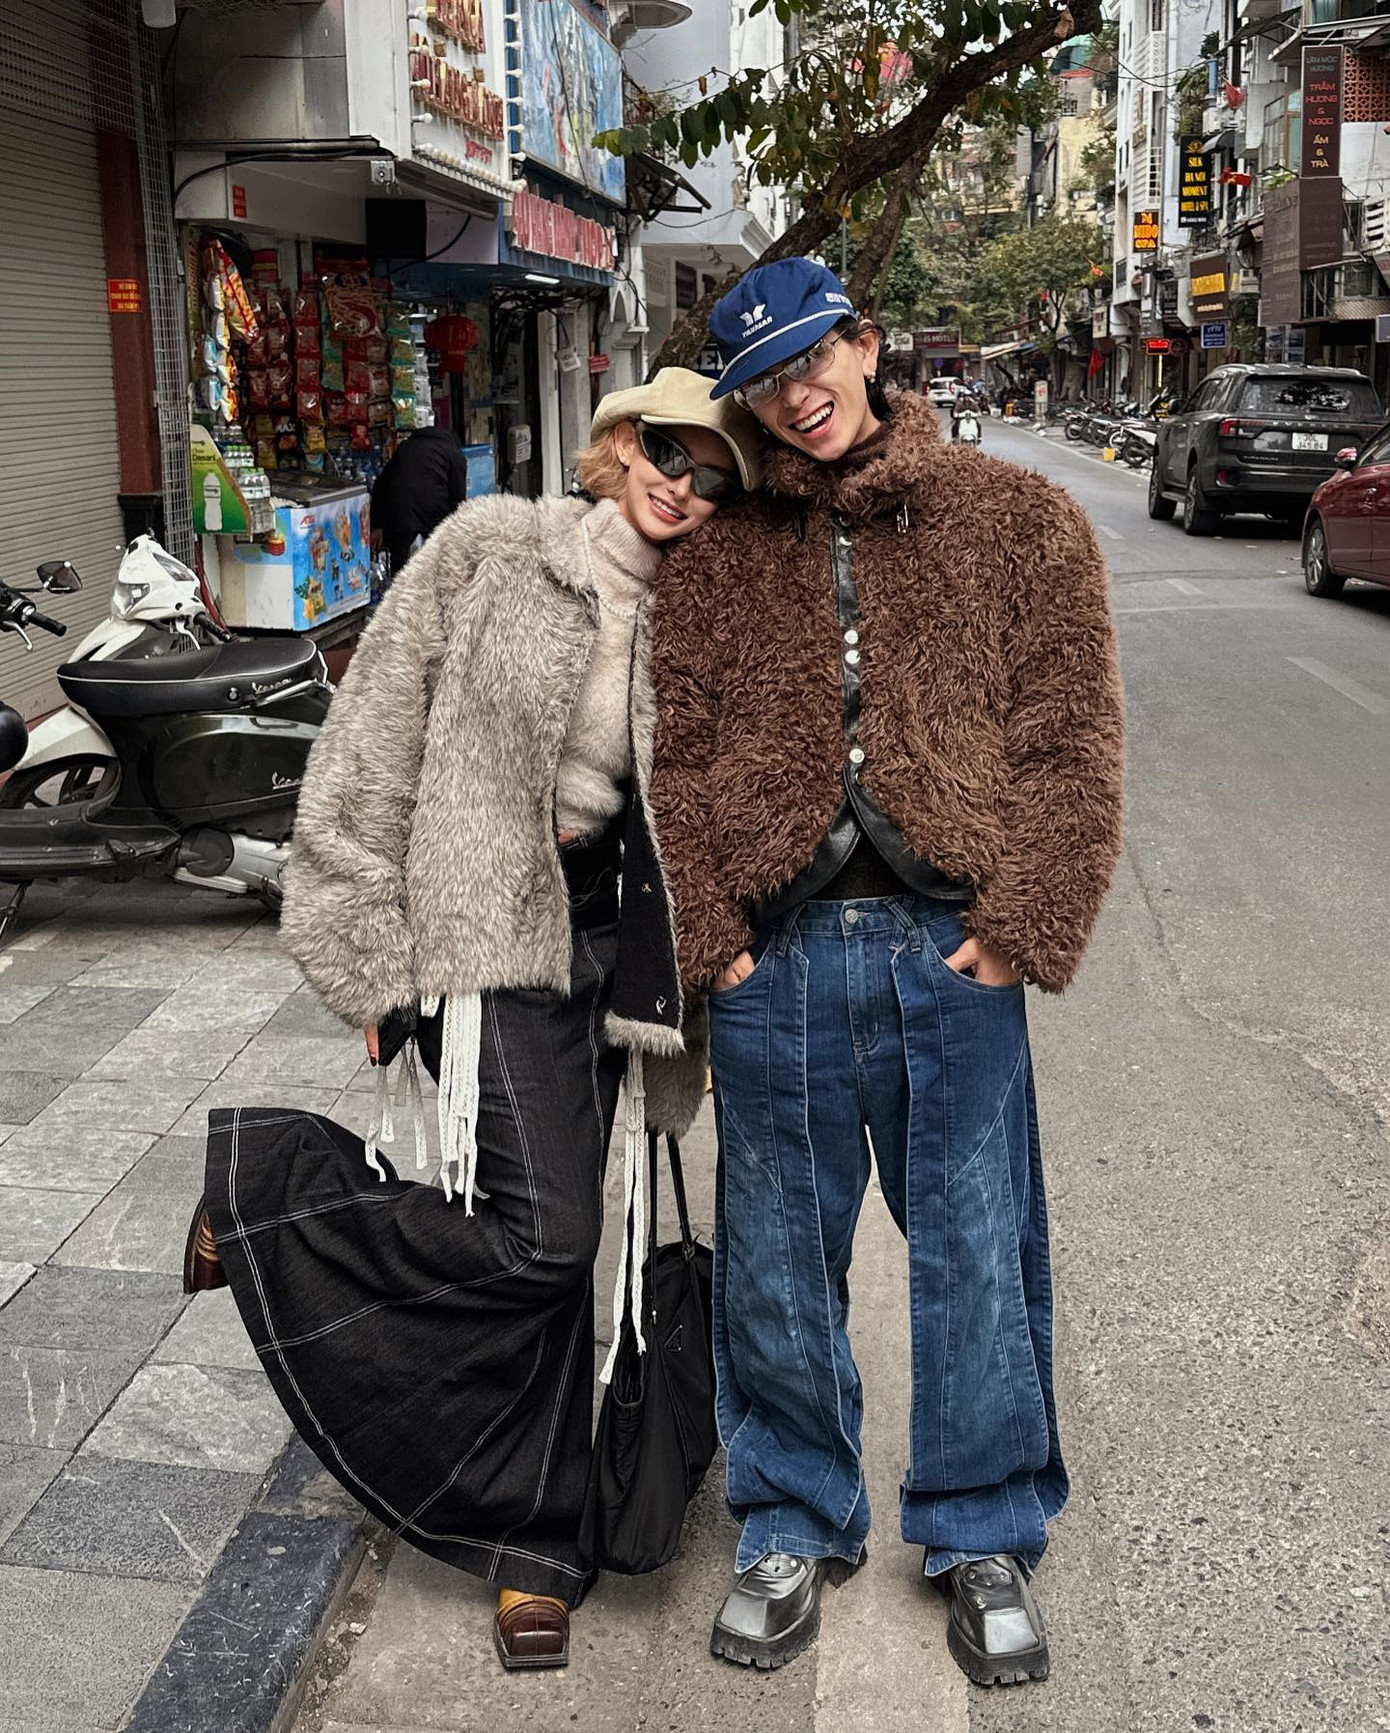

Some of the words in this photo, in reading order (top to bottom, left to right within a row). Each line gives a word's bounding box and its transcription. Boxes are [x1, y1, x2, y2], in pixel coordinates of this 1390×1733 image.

[1310, 159, 1329, 168] TRÀ
[1182, 185, 1208, 197] MOMENT
[1135, 239, 1156, 249] SPA
[741, 316, 773, 338] YANMAR
[192, 453, 216, 462] Dasani
[252, 677, 292, 694] Vespa
